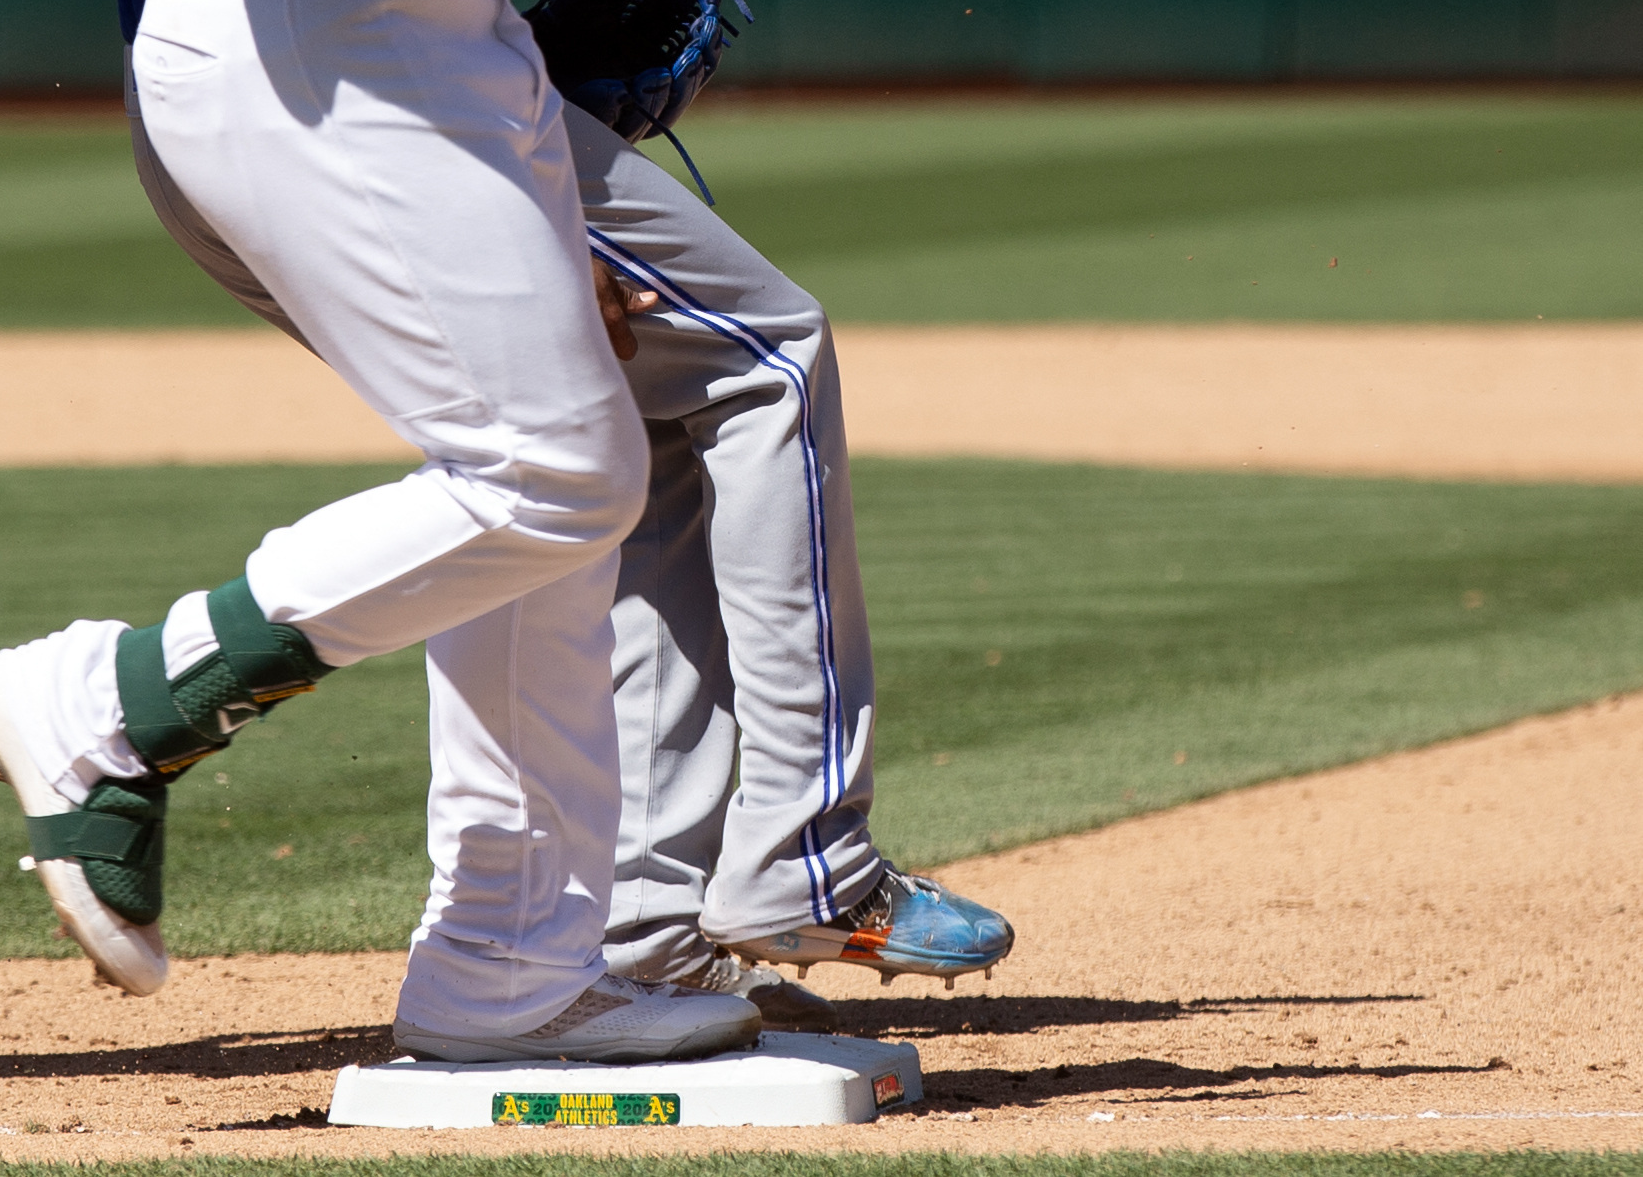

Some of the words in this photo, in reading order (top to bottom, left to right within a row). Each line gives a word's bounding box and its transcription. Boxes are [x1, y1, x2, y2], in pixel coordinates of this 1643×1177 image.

[560, 1094, 613, 1109] OAKLAND
[642, 1095, 676, 1124] A's
[555, 1110, 618, 1125] ATHLETICS
